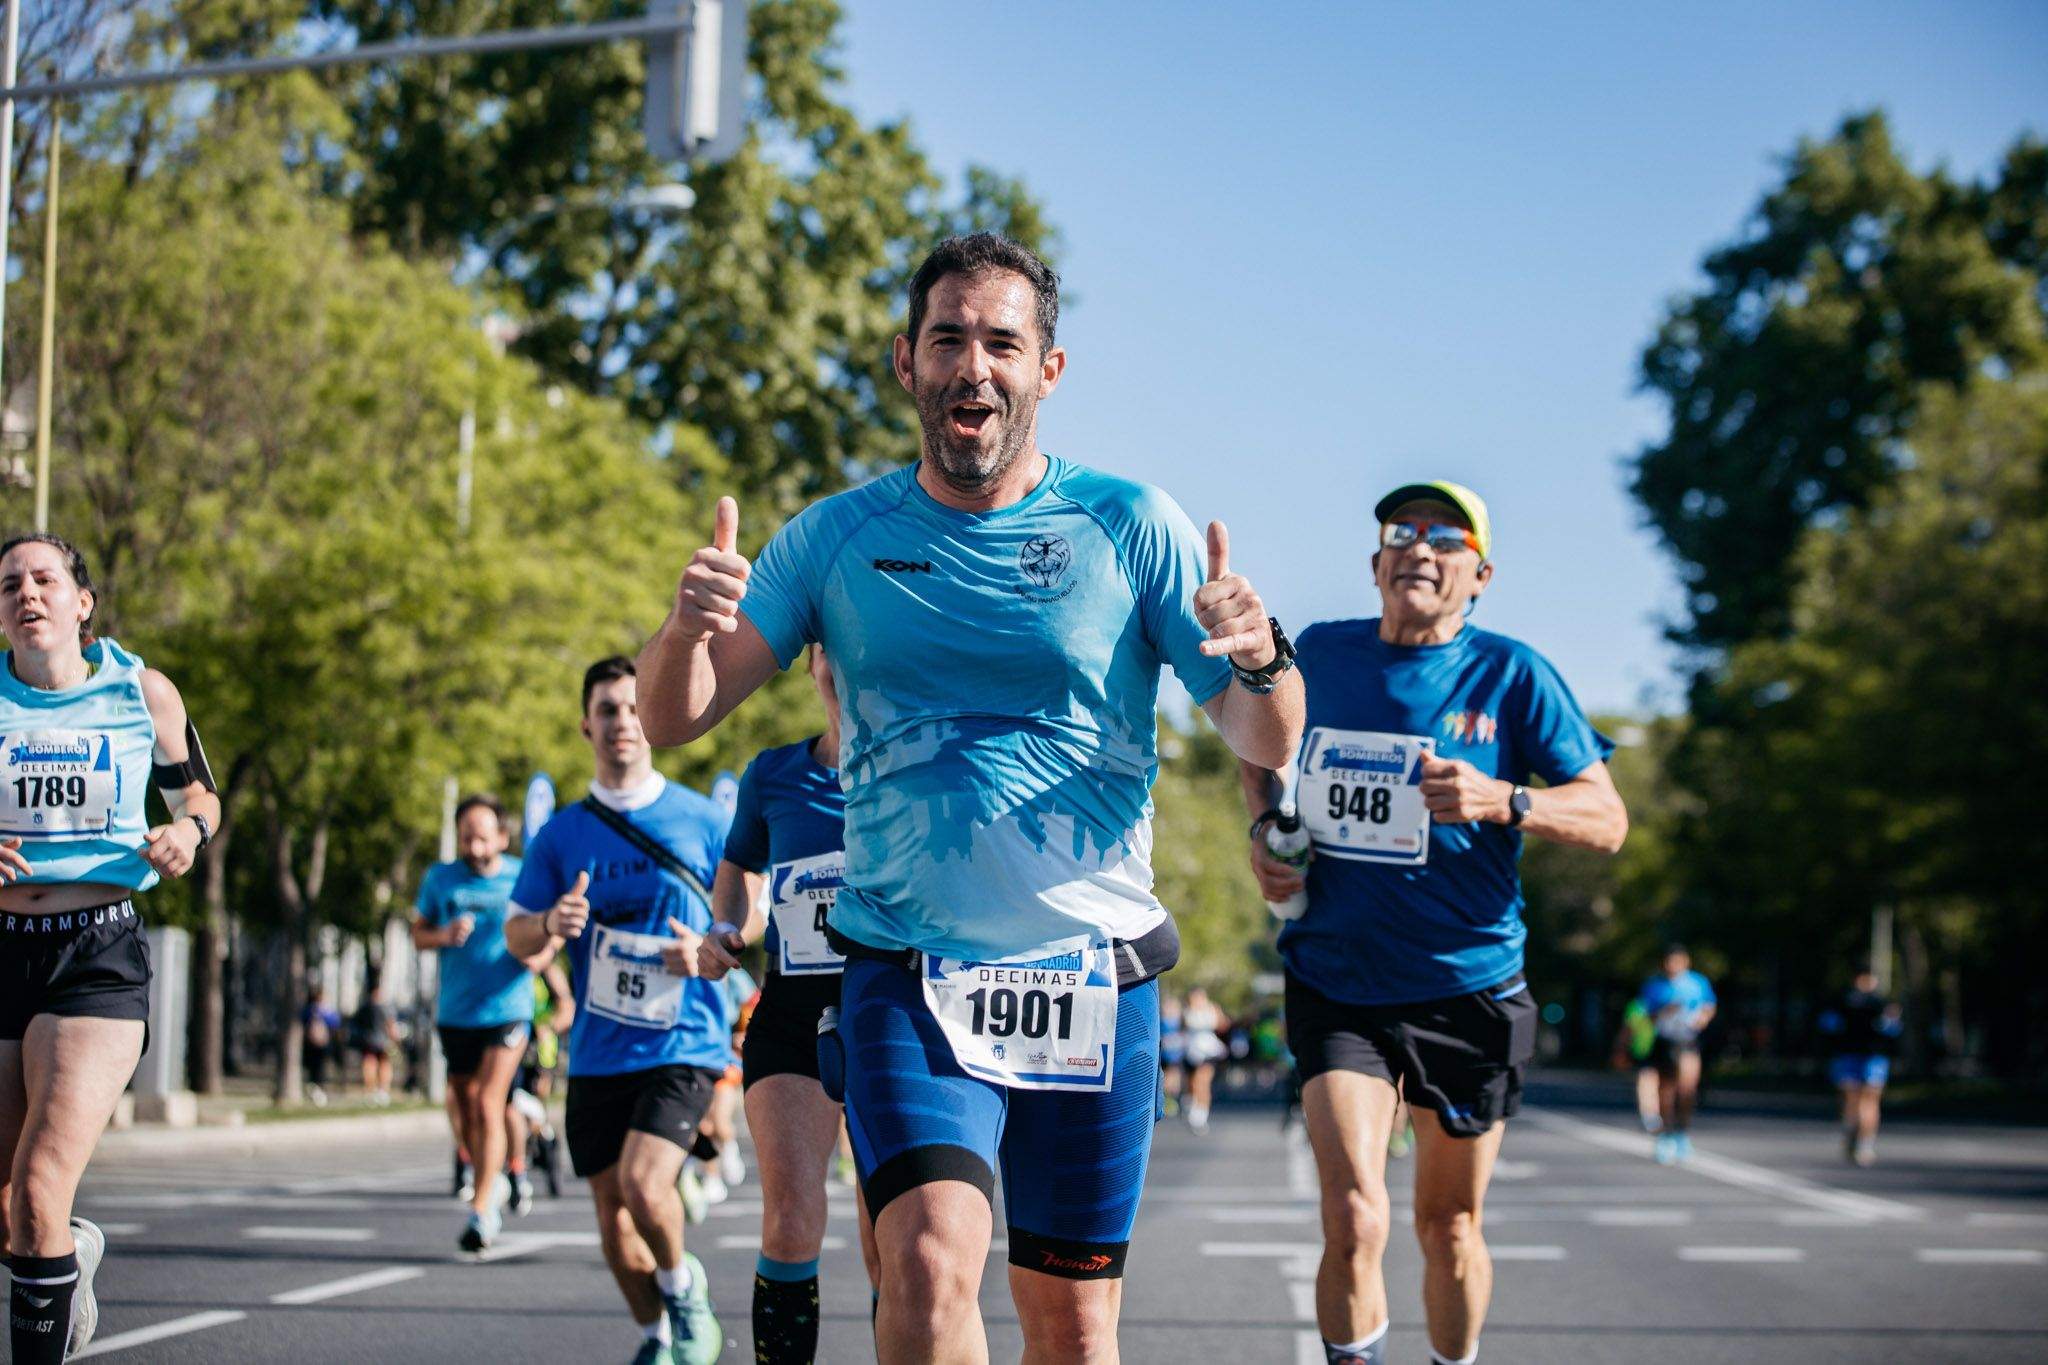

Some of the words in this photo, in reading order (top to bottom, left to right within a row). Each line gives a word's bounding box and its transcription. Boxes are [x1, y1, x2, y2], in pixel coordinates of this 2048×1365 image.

[873, 559, 931, 574] KON
[21, 764, 87, 773] DECIMAS
[1331, 769, 1401, 785] DECIMAS
[13, 776, 87, 809] 1789
[1328, 783, 1392, 825] 948
[814, 903, 836, 937] 4
[1040, 956, 1080, 970] MADRID
[617, 971, 646, 999] 85
[980, 969, 1077, 986] DECIMAS
[966, 988, 1073, 1040] 1901
